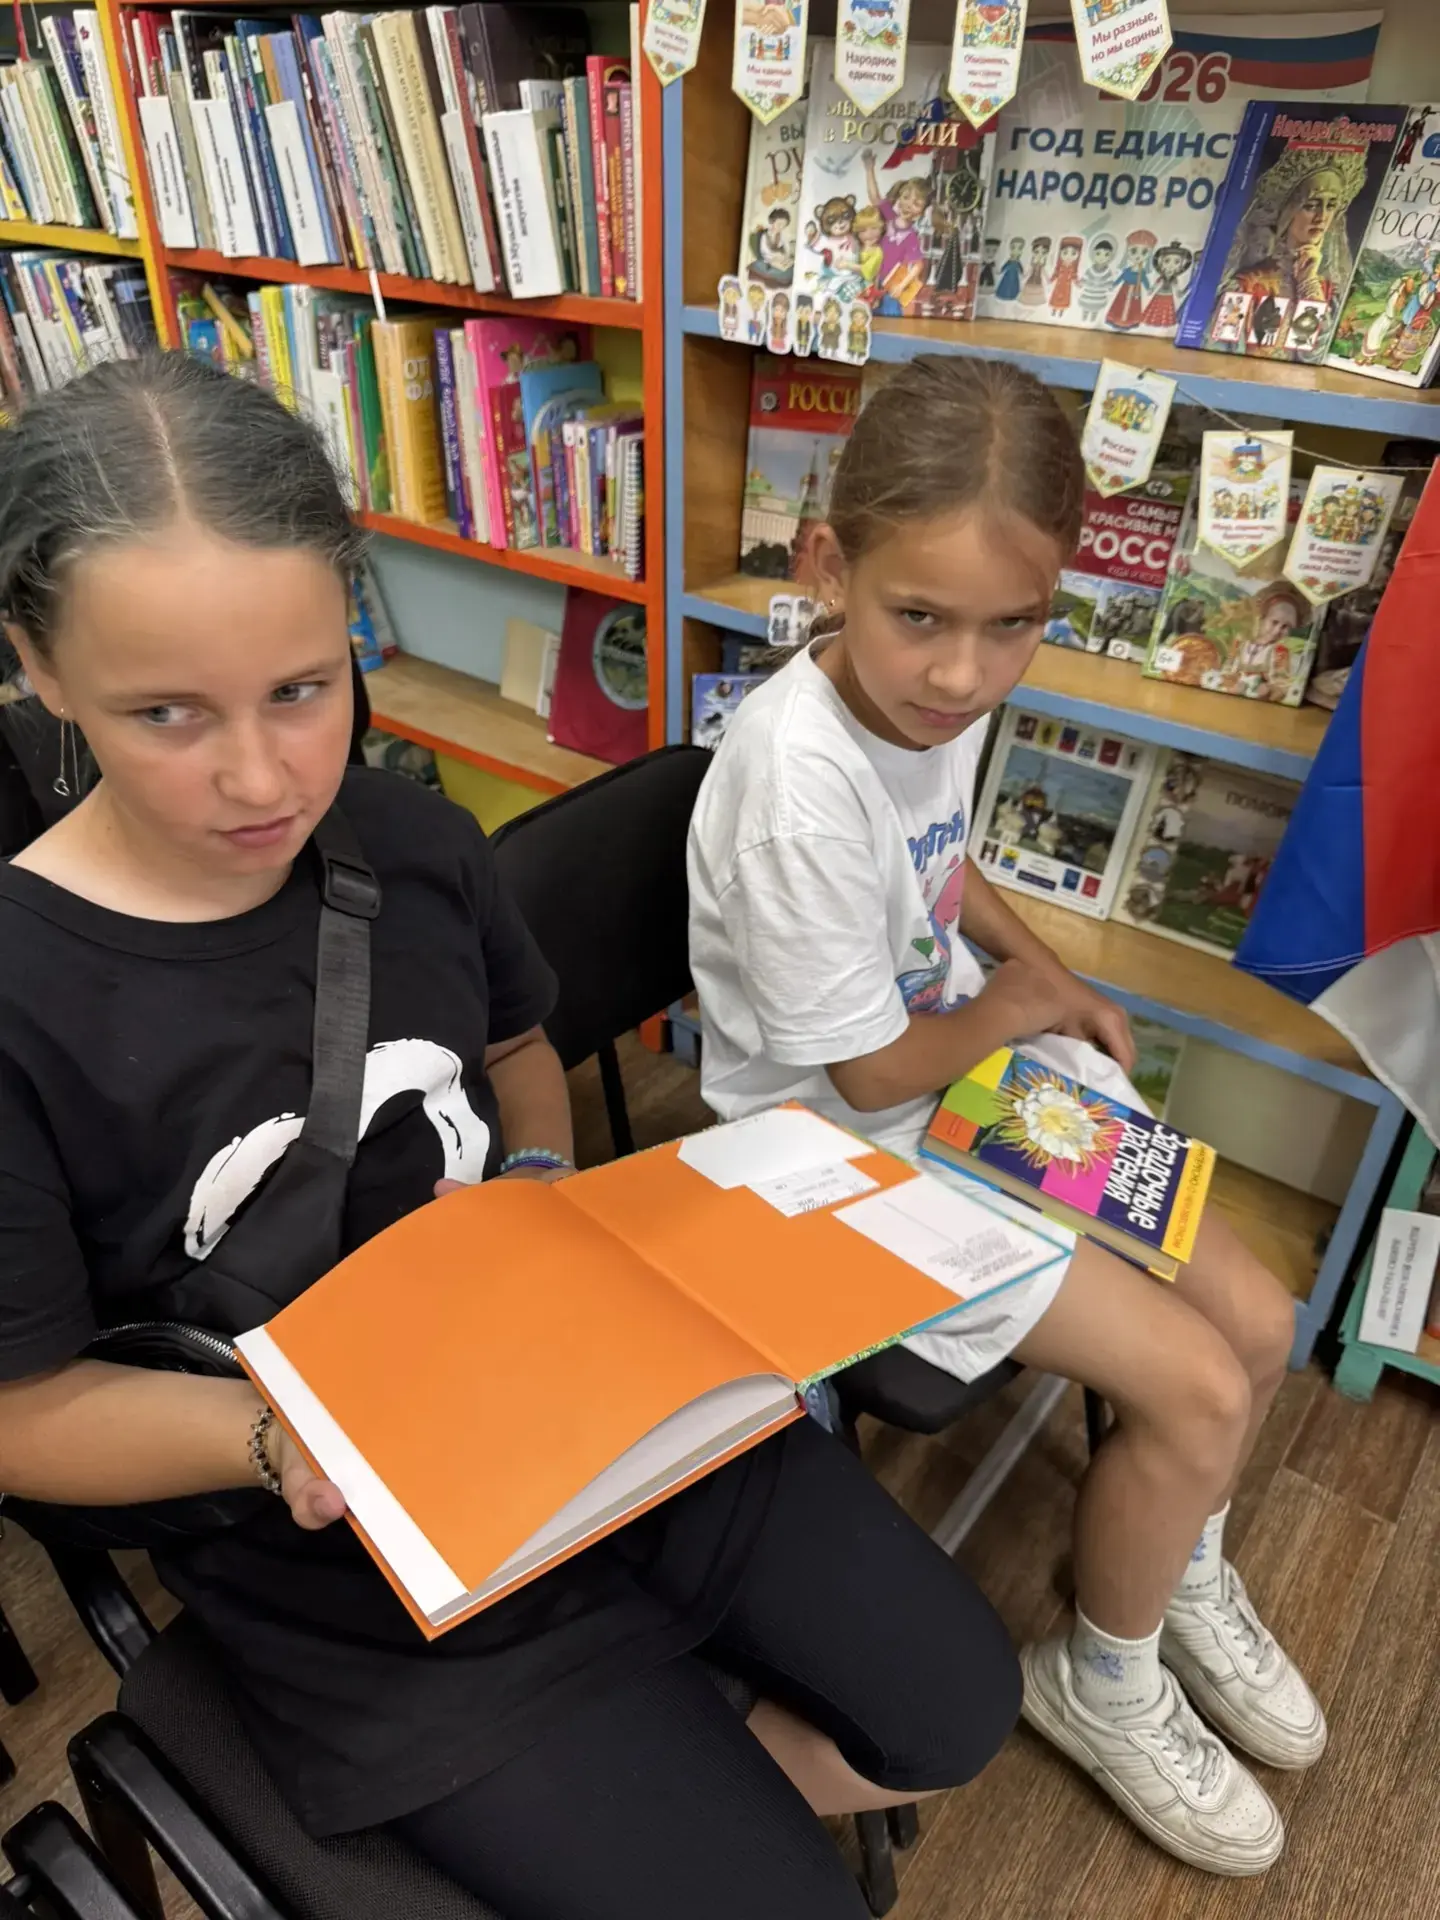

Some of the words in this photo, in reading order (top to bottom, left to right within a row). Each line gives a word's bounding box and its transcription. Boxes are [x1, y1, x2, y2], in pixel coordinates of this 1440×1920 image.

[1091, 31, 1111, 46] Мы
[1113, 11, 1158, 40] разные,
[1091, 53, 1104, 63] но
[1107, 42, 1124, 56] мы
[1124, 24, 1164, 49] едины!
[845, 53, 896, 69] Народное
[870, 102, 934, 119] ИВЕМ
[841, 120, 961, 147] РОССИИ
[1271, 114, 1331, 141] Народы
[1011, 127, 1084, 158] ГОД
[1093, 129, 1239, 161] ЕДИНС
[995, 168, 1159, 210] НАРОДОВ
[1088, 511, 1161, 536] КРАСИВЫЕ
[1126, 502, 1181, 523] САМЫЕ
[1104, 1116, 1150, 1206] растения
[1128, 1123, 1192, 1231] Загадочные
